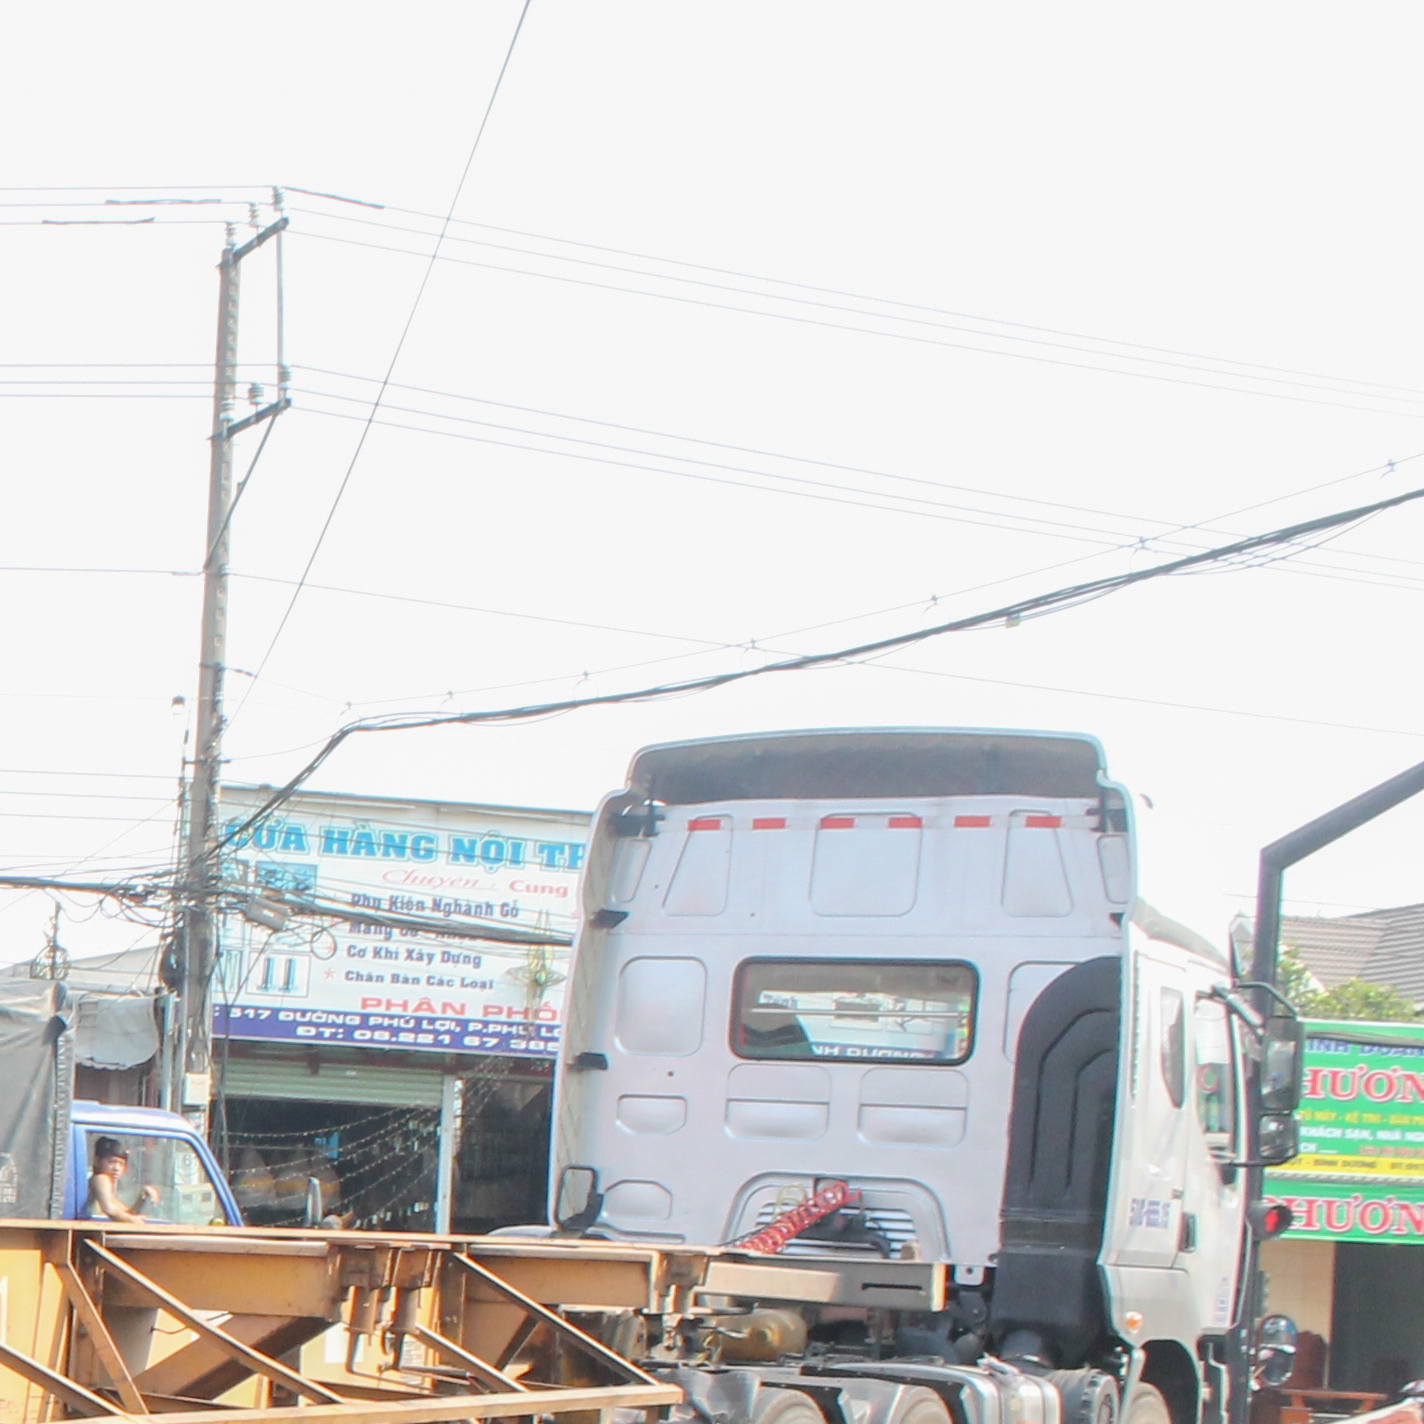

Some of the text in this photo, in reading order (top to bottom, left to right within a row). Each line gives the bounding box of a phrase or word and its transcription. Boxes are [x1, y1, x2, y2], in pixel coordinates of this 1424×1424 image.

[321, 821, 438, 862] HÀNG
[450, 831, 525, 873] NỘI
[509, 879, 569, 899] Cung
[278, 1010, 361, 1027] ĐƯỜNG
[368, 1015, 416, 1030] PHÚ
[360, 996, 562, 1022] PHÂN PHỐ
